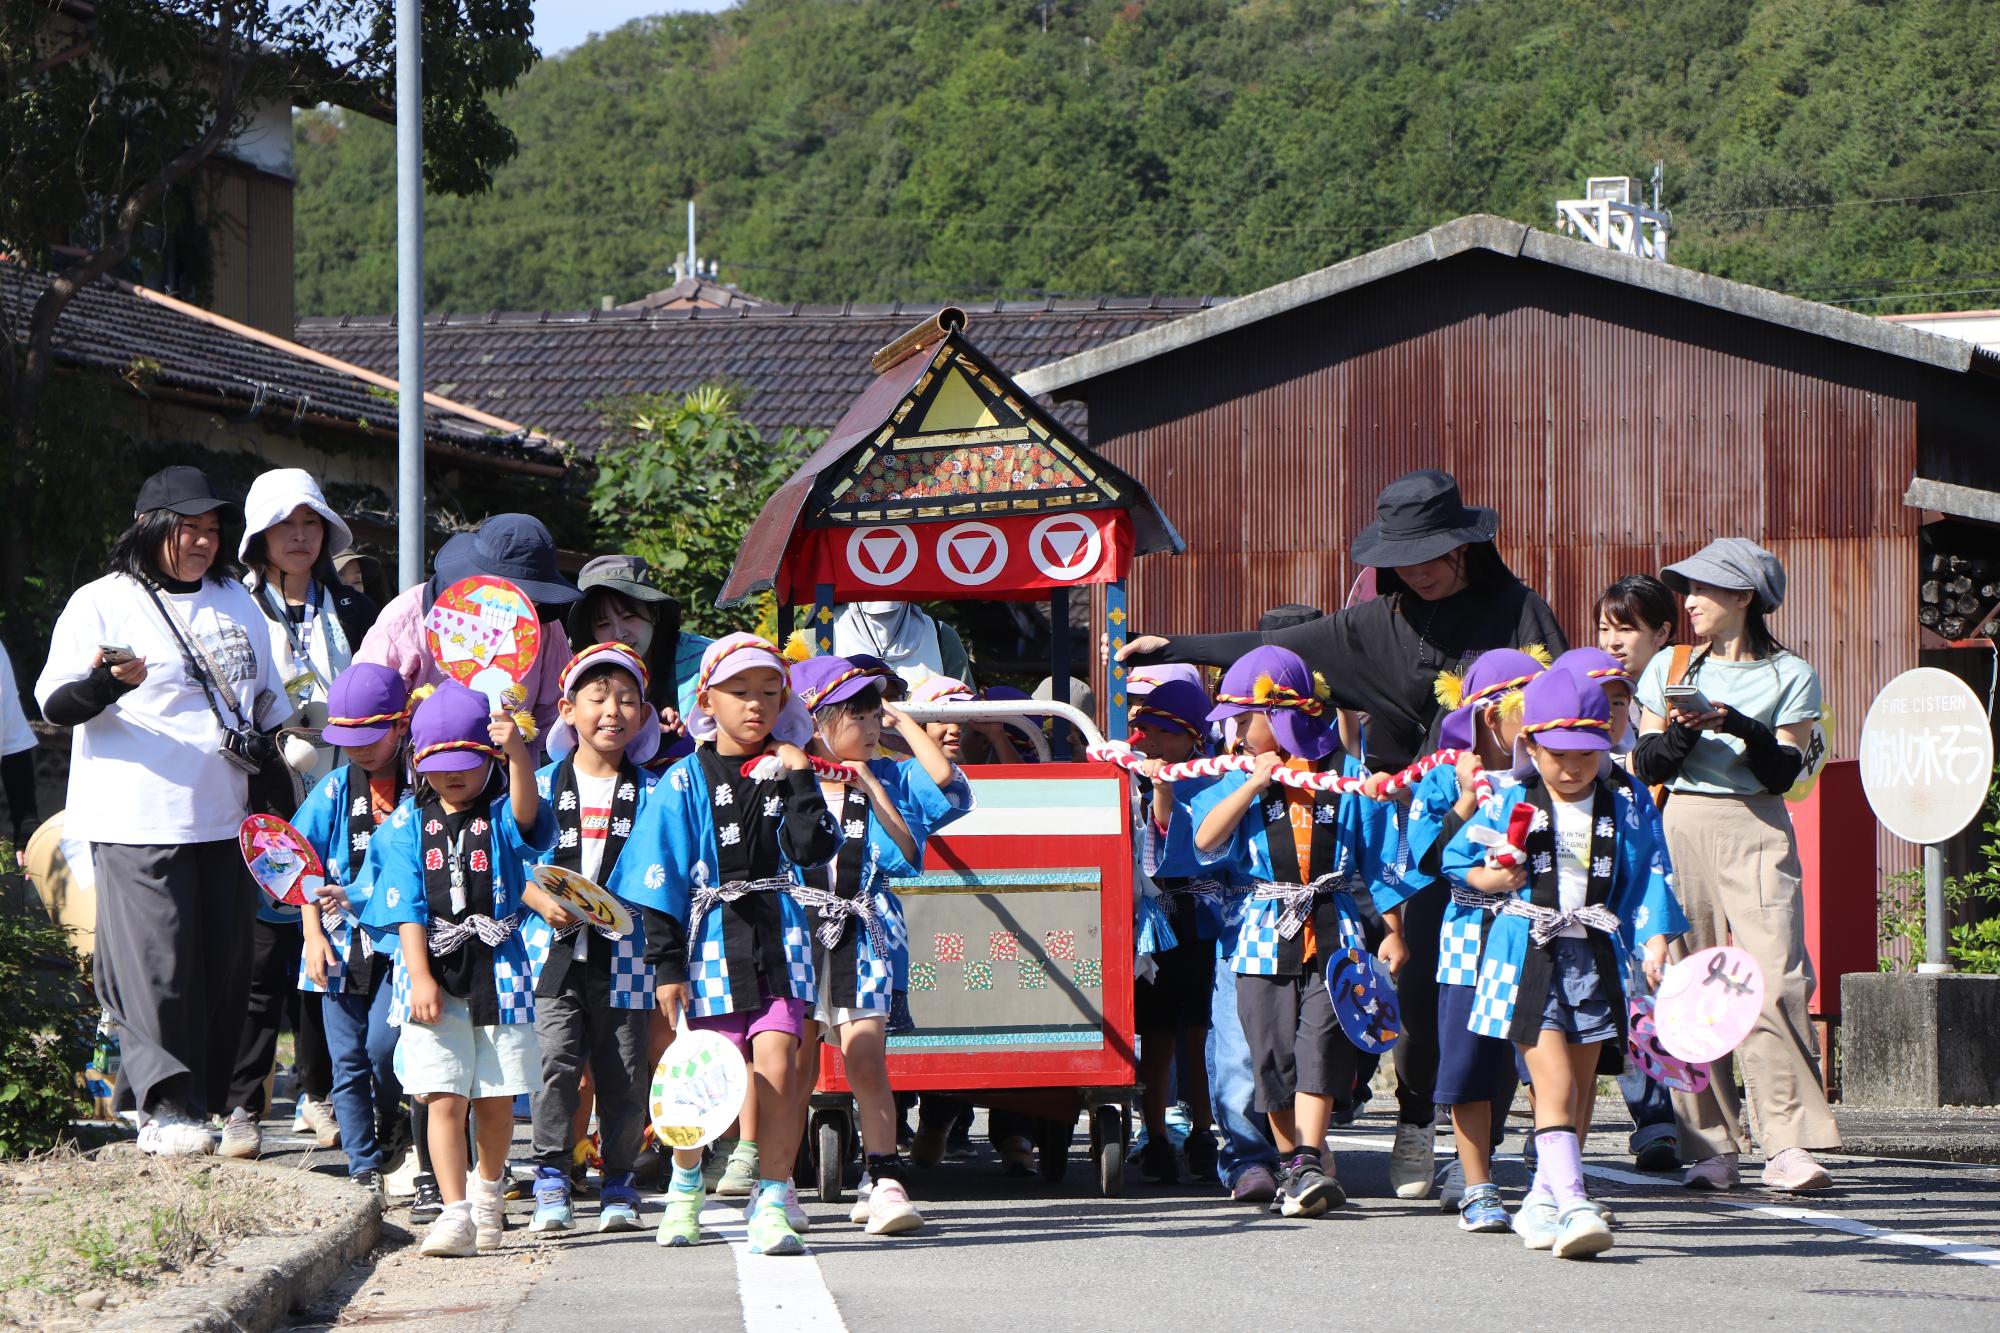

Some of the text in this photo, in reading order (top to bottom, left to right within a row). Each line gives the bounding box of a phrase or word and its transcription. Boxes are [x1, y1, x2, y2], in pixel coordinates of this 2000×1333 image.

[1881, 694, 1967, 714] FIRE CISTERN
[1868, 724, 1985, 789] 防火水そう
[425, 819, 444, 871] 小若
[470, 817, 488, 872] 小若
[583, 816, 609, 830] LEGO
